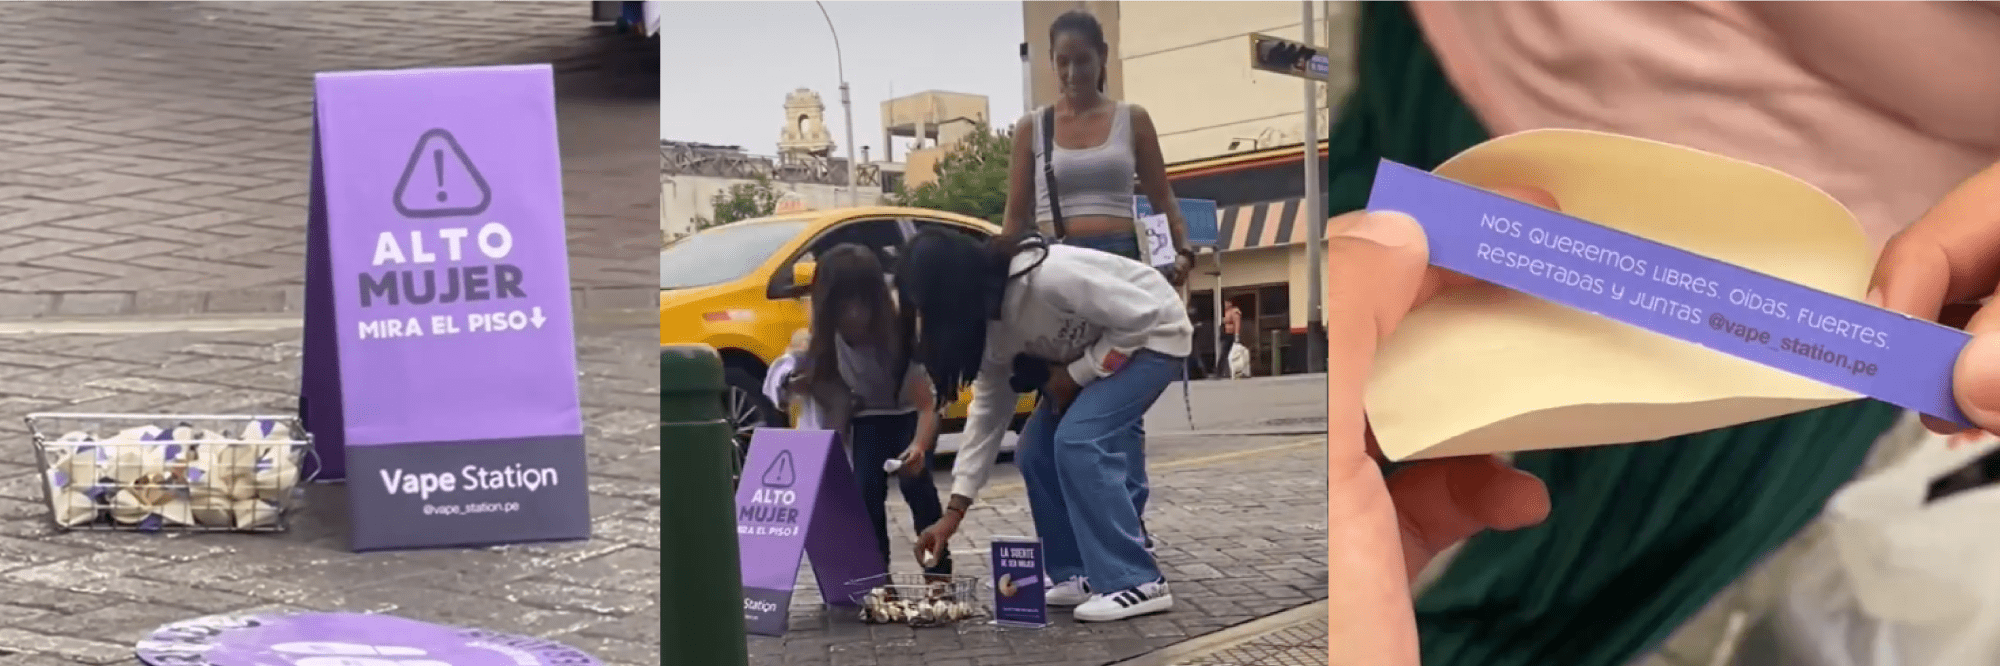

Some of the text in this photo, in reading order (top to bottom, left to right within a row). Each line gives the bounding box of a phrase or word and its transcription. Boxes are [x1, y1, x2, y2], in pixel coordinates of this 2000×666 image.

[1480, 213, 1522, 238] NOS
[372, 222, 513, 266] ALTO
[357, 264, 528, 308] MUJER
[357, 309, 528, 341] MIRA EL PISO
[1629, 291, 1703, 325] JUNTAS
[1708, 312, 1879, 377] @vape_station.pe
[379, 463, 559, 500] Vape Station
[422, 500, 521, 516] @vape_station.pe
[751, 489, 796, 505] ALTO
[738, 505, 799, 524] MUJER
[743, 597, 777, 613] Station
